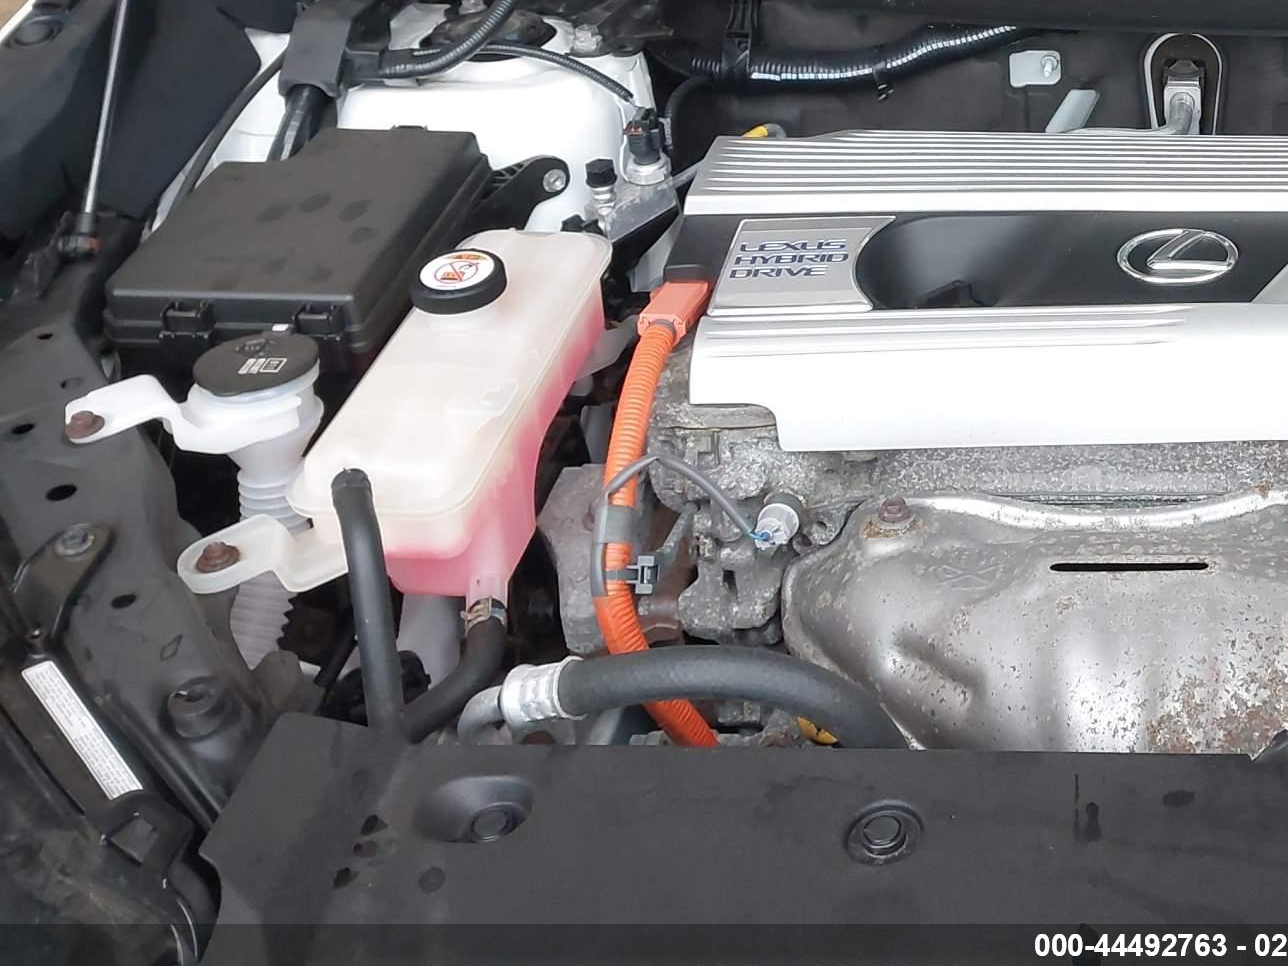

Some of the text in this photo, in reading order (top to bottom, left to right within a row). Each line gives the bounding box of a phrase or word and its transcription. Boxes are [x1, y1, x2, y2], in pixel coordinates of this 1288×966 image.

[740, 239, 847, 252] LEXUS
[734, 251, 849, 265] HYBRID
[729, 265, 828, 279] DRIVE
